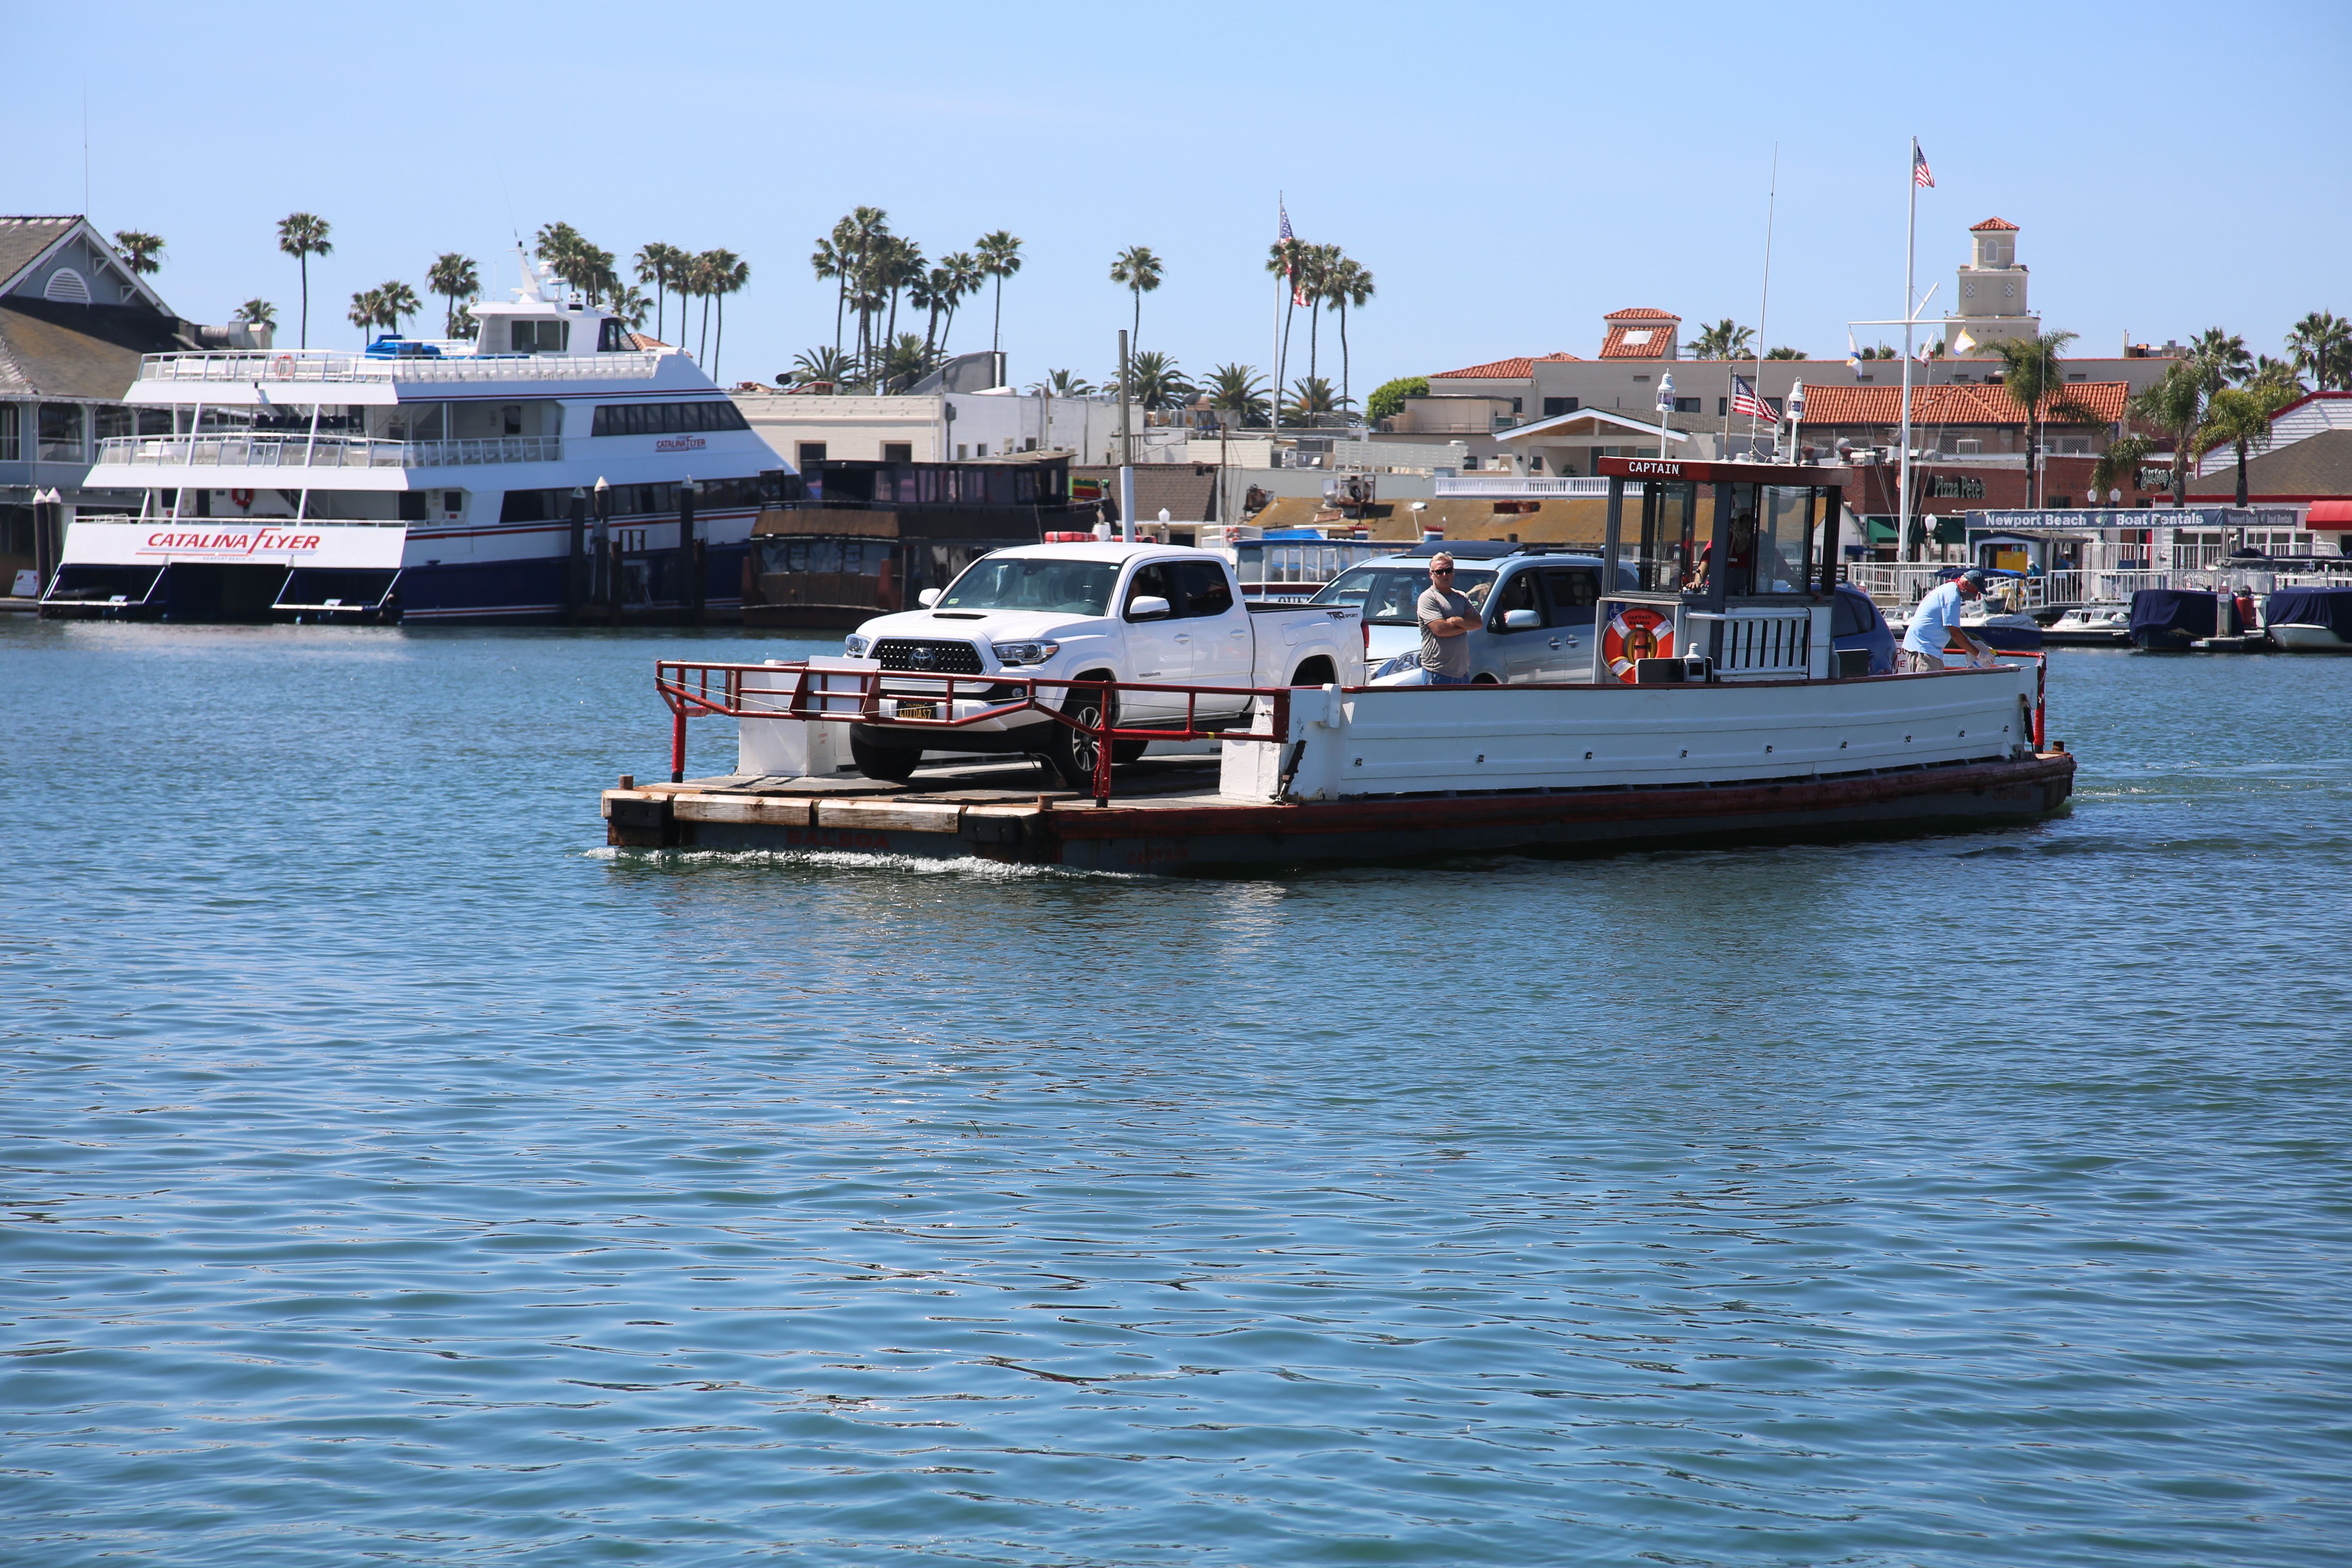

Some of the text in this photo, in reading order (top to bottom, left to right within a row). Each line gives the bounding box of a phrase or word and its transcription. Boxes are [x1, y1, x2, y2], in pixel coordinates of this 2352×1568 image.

[656, 440, 686, 448] CATALINA
[1629, 461, 1679, 474] CAPTAIN
[1934, 475, 1986, 499] Pizza Pete's
[1986, 514, 2041, 527] Newport
[2045, 514, 2086, 526] Beach
[2116, 514, 2147, 525] Boat
[2228, 514, 2292, 525] Newport Beach Boat Rentals
[148, 528, 320, 555] CATALINA FLYER
[1326, 611, 1345, 621] TRD
[786, 830, 890, 849] BALBOA
[1127, 845, 1189, 865] CAPTAIN
